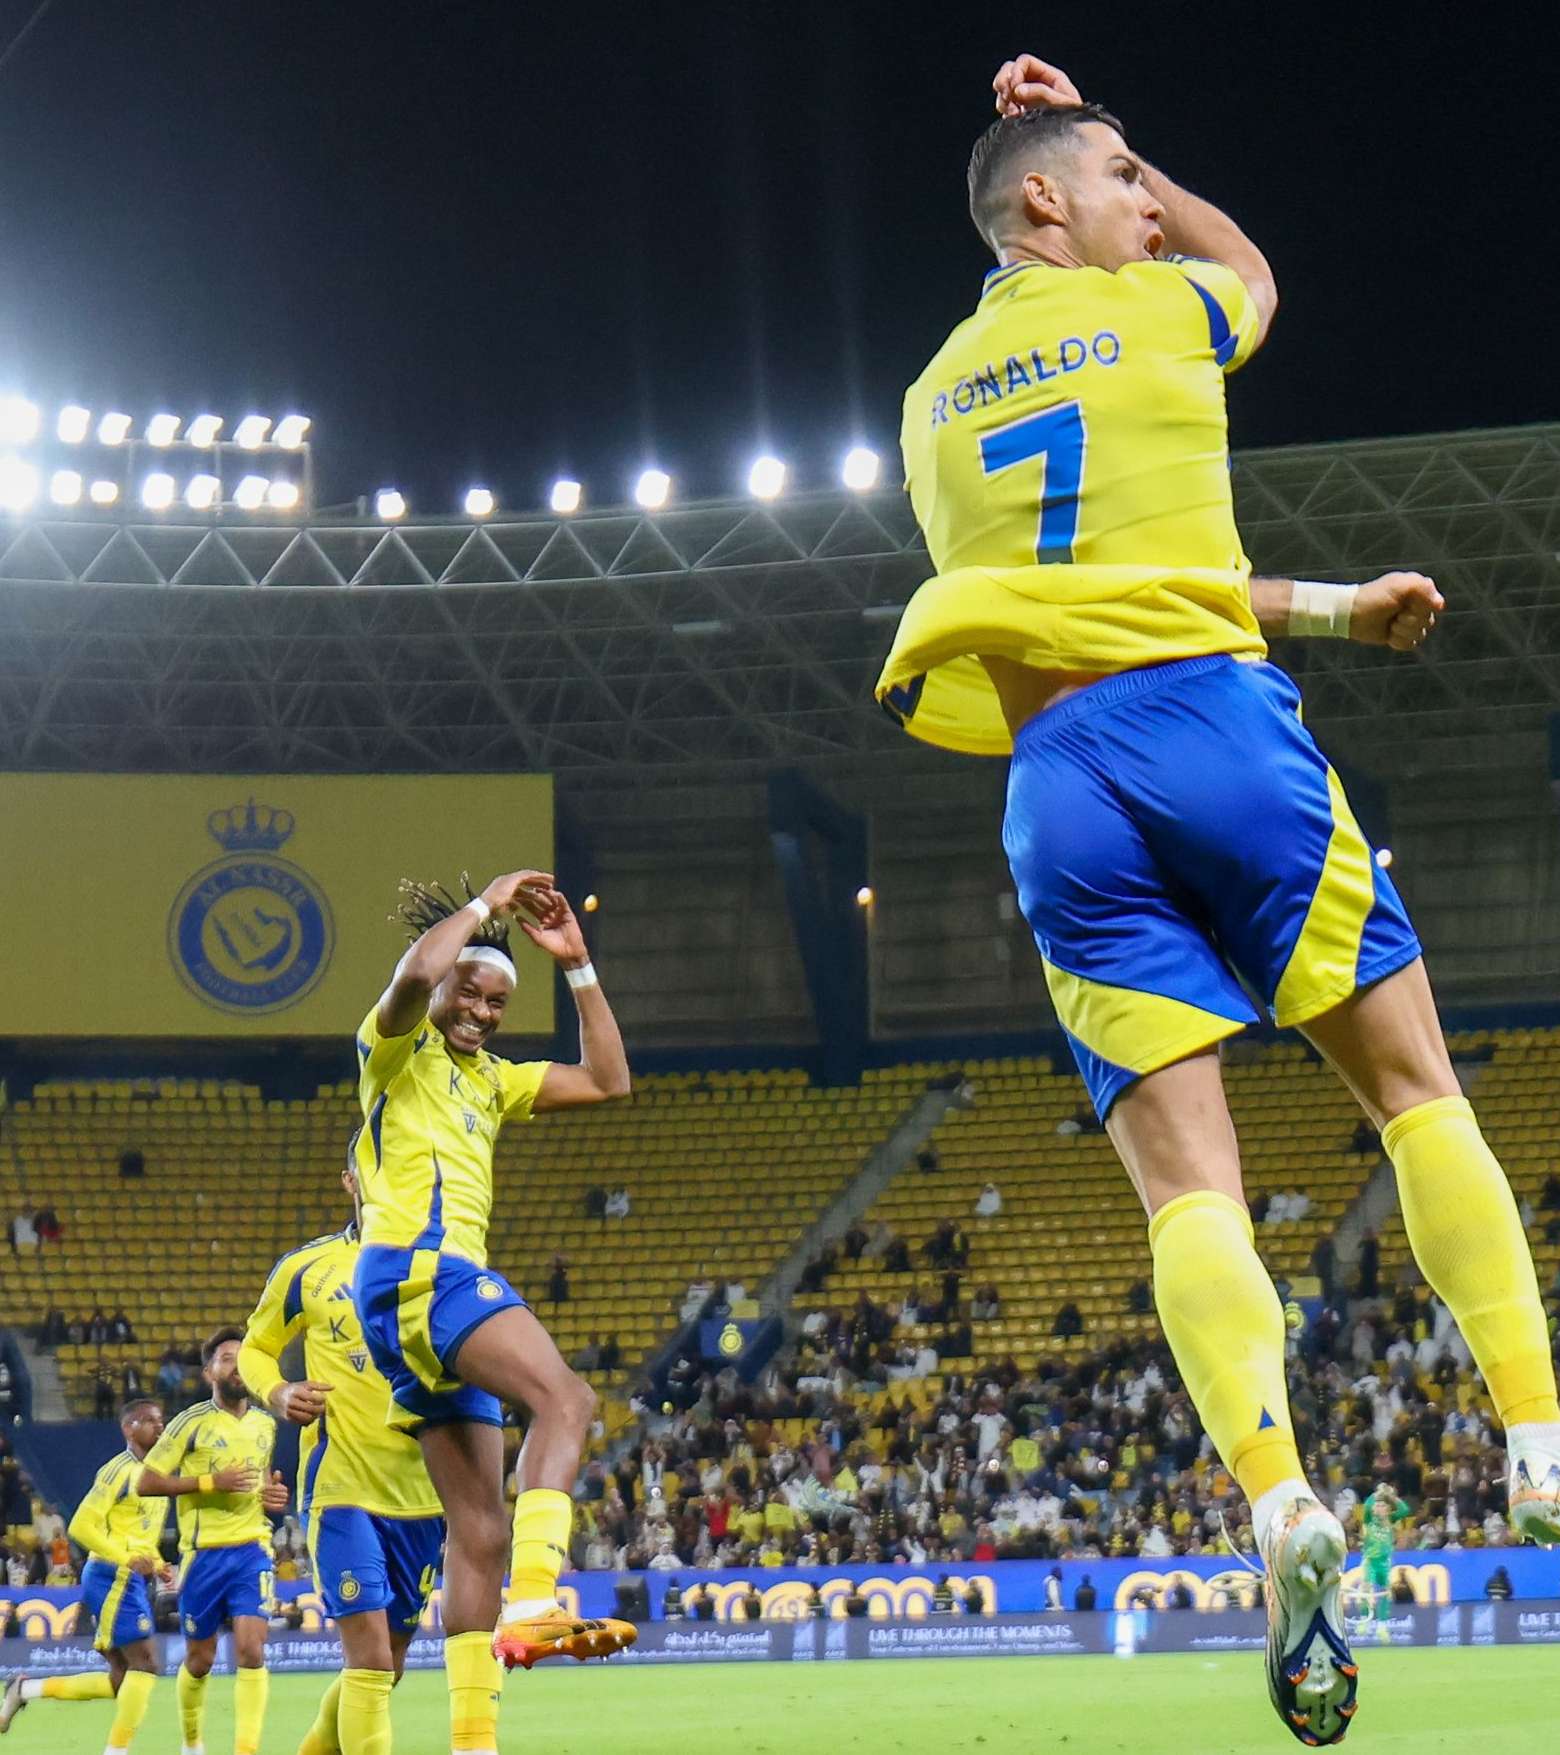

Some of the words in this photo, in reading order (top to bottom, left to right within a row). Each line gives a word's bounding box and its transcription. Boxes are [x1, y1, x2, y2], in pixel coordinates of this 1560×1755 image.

[932, 331, 1121, 429] RONALDO
[978, 399, 1087, 565] 7
[868, 1628, 898, 1641] LIVE
[901, 1627, 970, 1641] THROUGH
[971, 1626, 999, 1639] THE
[1000, 1624, 1072, 1639] MOMENTS
[1519, 1612, 1550, 1626] LIVE
